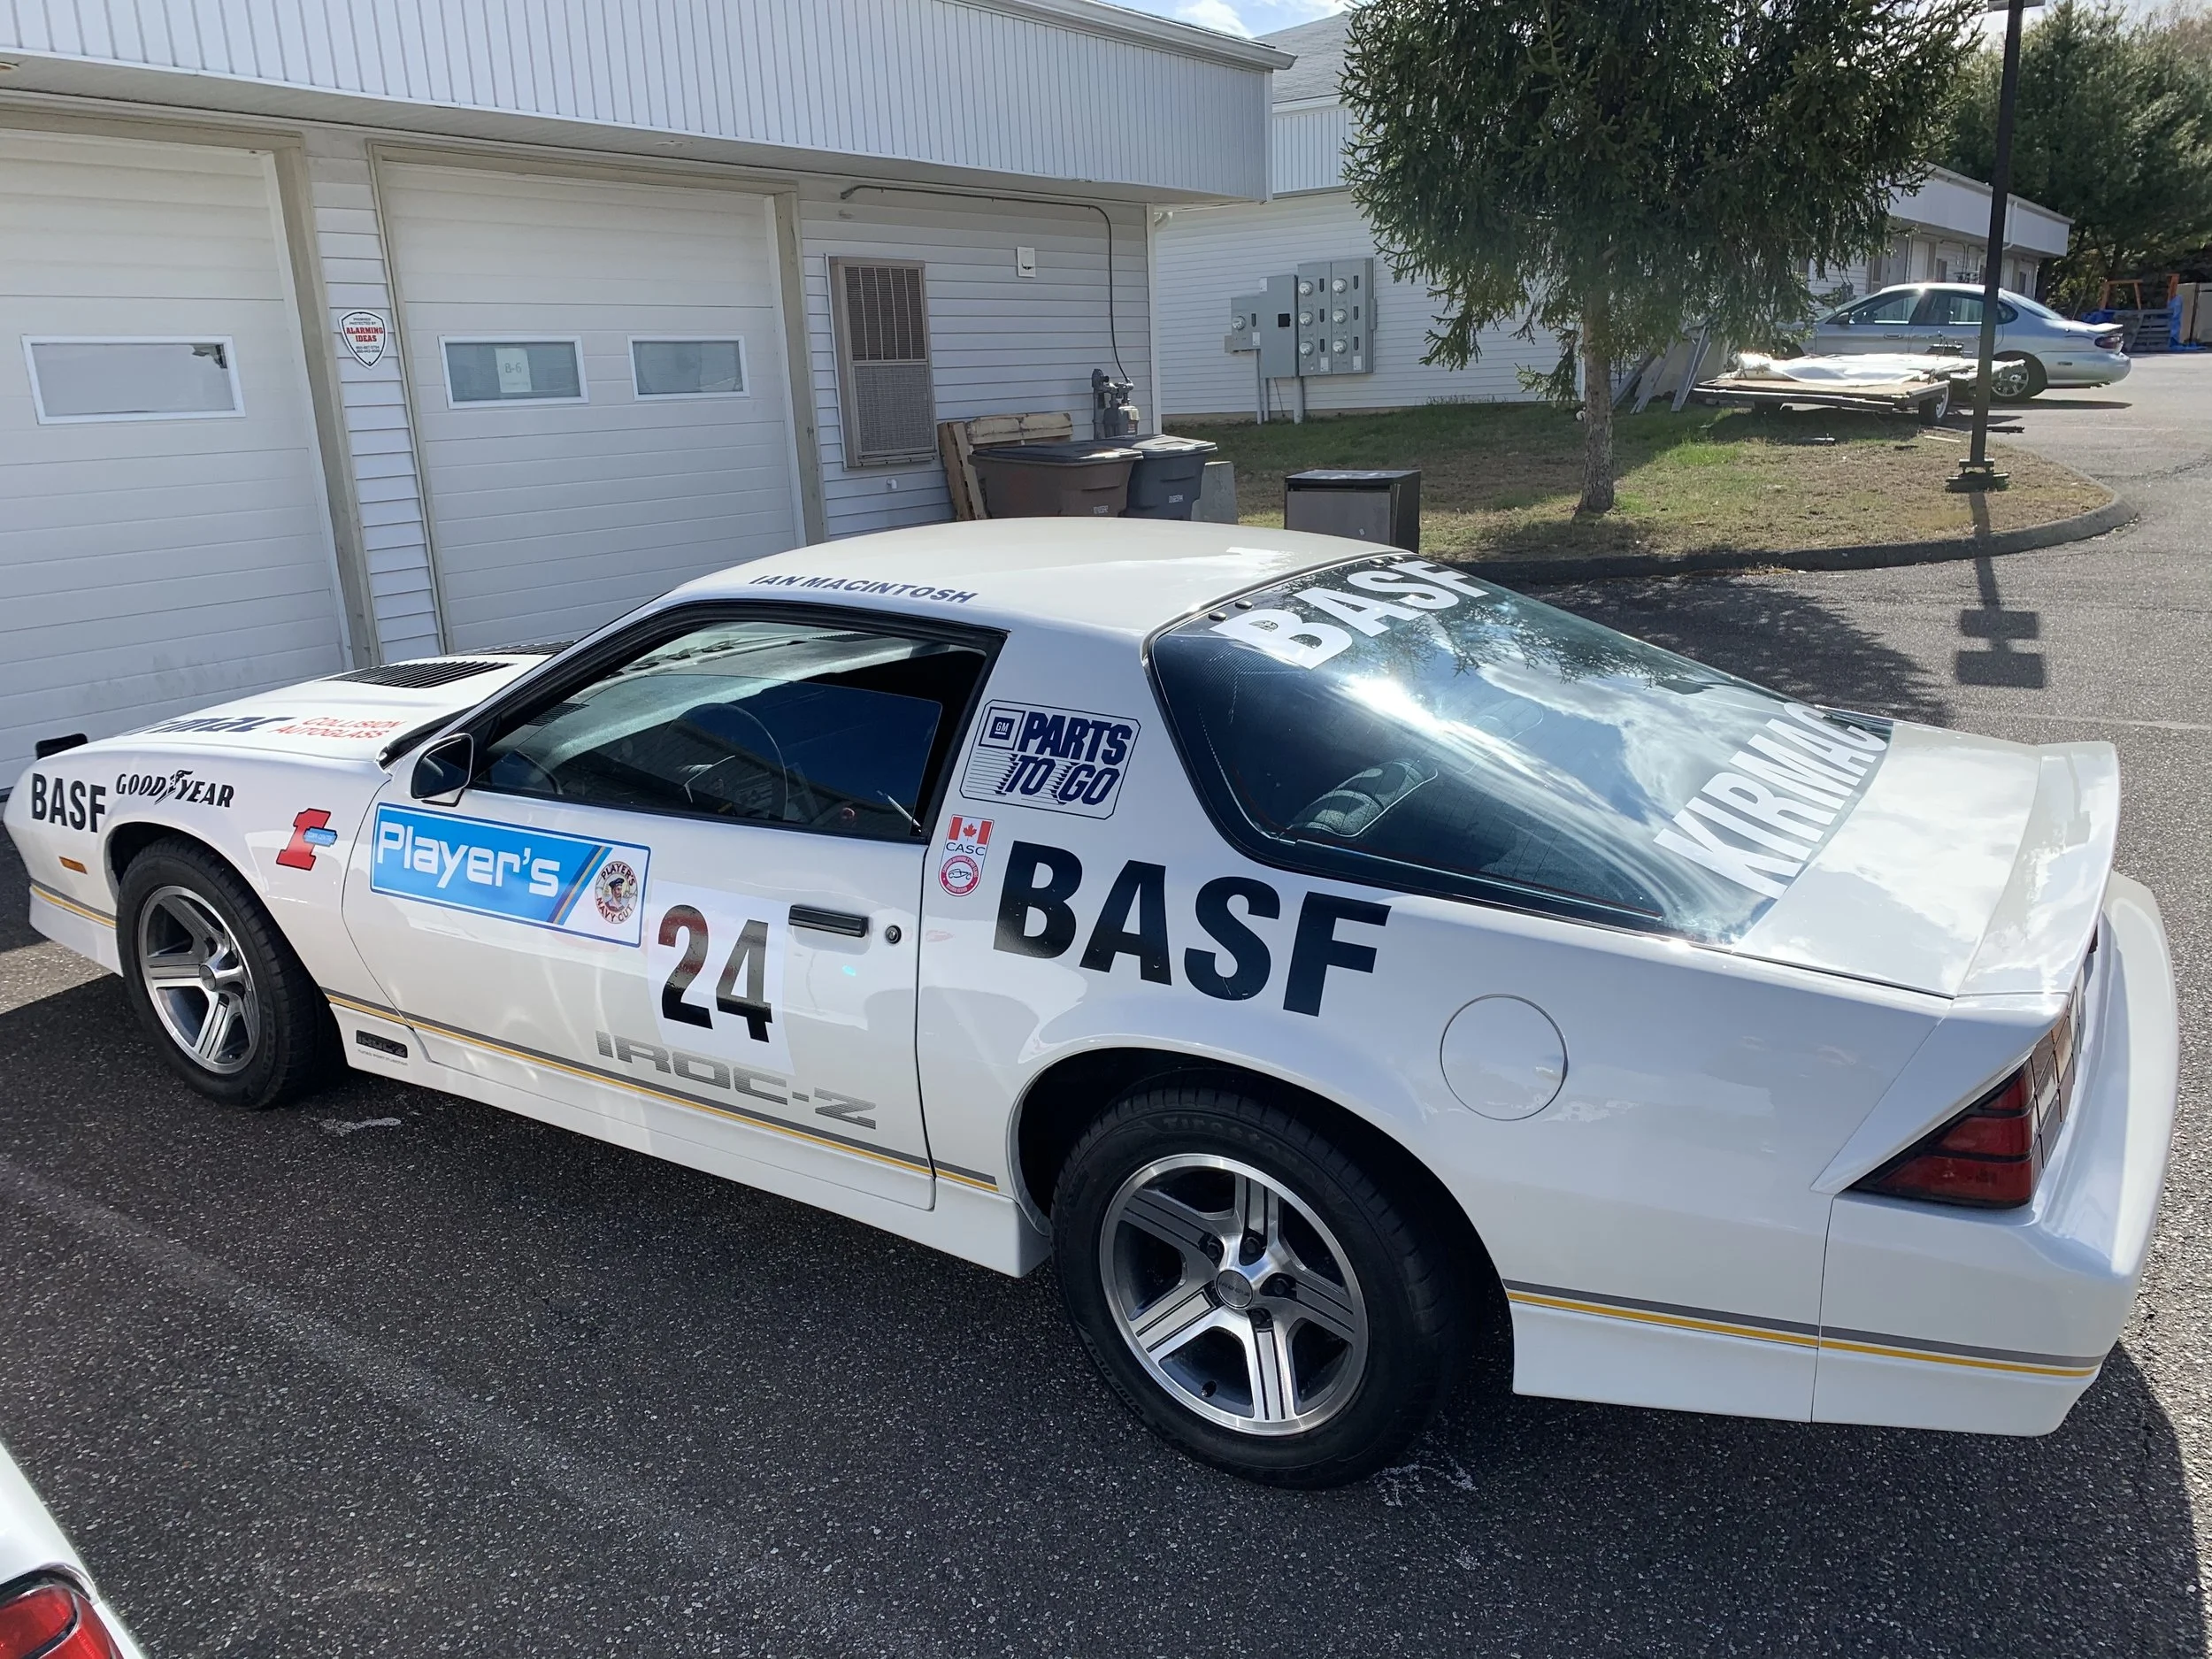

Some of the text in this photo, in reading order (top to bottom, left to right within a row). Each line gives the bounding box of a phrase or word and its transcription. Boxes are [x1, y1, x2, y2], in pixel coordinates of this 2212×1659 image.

[749, 575, 979, 603] IAN MACINTOSH
[1209, 559, 1491, 670] BASF
[267, 725, 389, 739] AUTOGLASS
[302, 717, 407, 728] COLLISION
[1018, 710, 1133, 766] PARTS
[31, 772, 106, 833] BASF
[1004, 755, 1121, 806] TO GO
[1653, 702, 1888, 901] KIRMAC
[377, 821, 560, 898] Player's
[601, 863, 636, 887] PLAYER'S
[946, 841, 986, 856] CASC
[596, 896, 634, 923] NAVY CUT
[993, 840, 1393, 1018] BASF
[657, 904, 773, 1043] 24
[595, 1030, 877, 1130] IROC-Z
